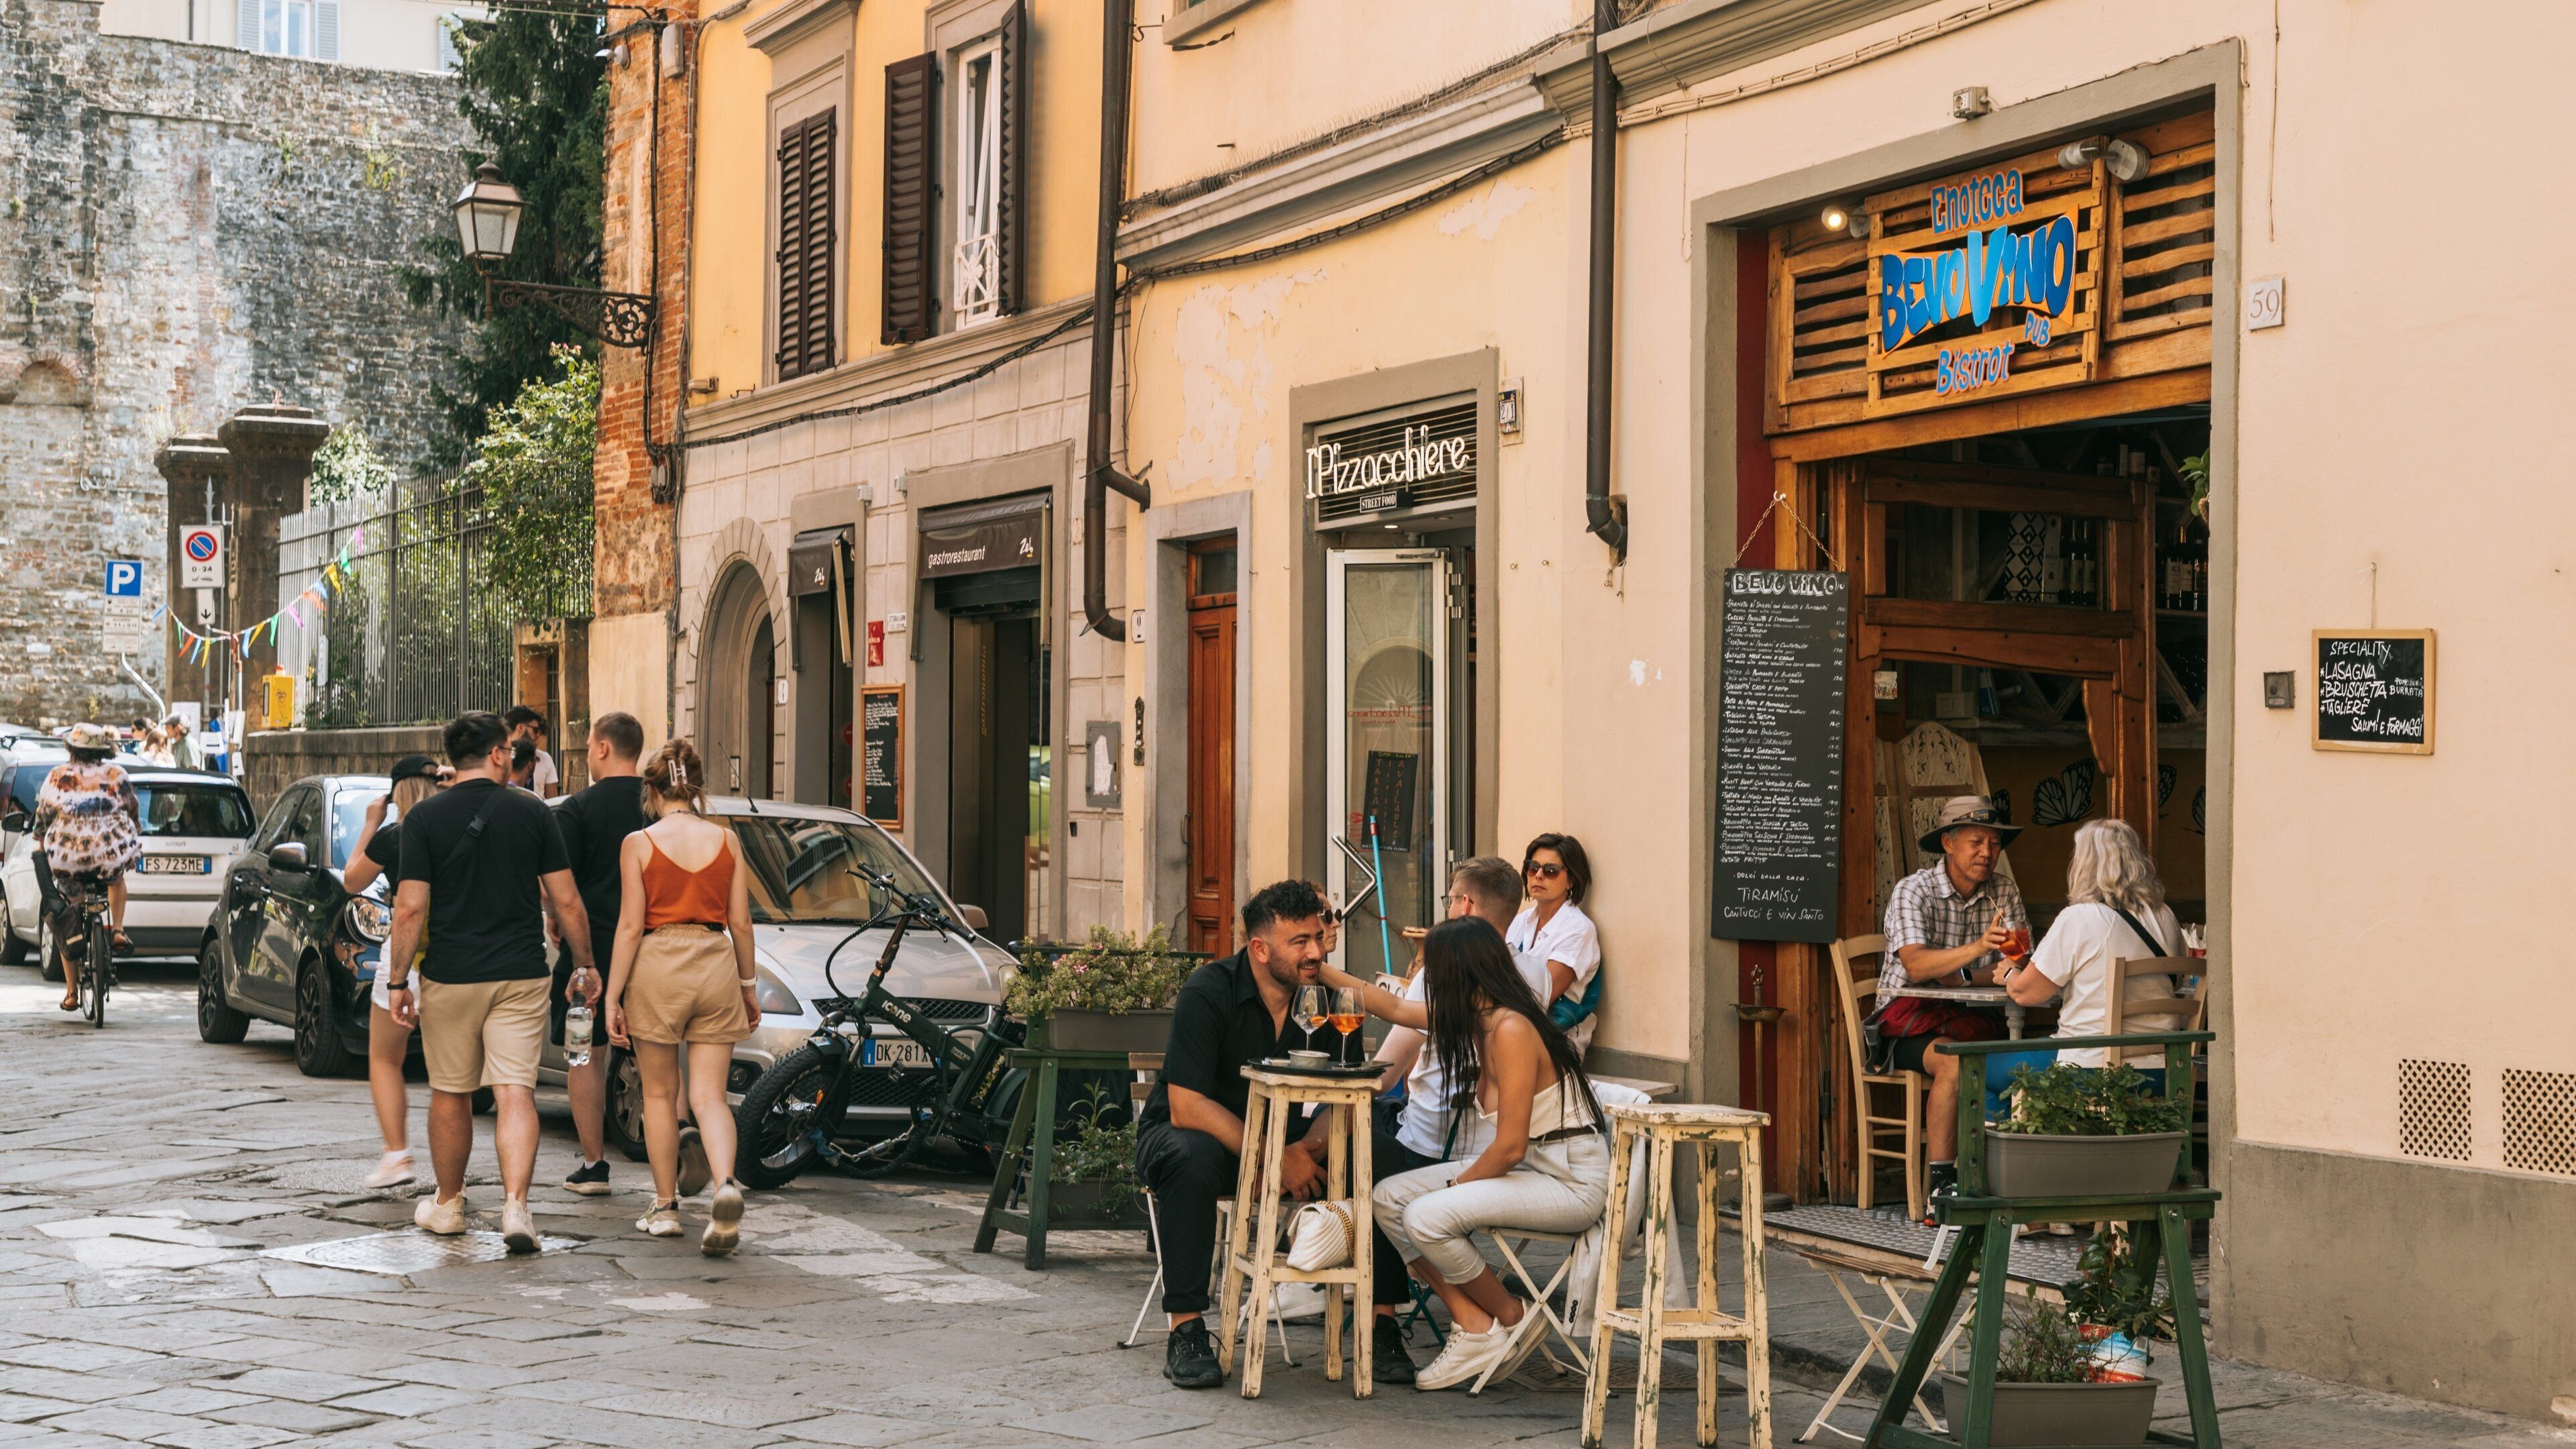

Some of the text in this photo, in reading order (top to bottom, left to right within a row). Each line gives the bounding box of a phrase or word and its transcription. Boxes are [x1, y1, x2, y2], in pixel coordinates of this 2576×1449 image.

[1931, 169, 2024, 234] Enoteca
[2250, 288, 2279, 320] 59
[2024, 311, 2051, 346] PUB
[1937, 341, 2014, 394] Bistrot
[1362, 494, 1395, 509] STREET FOOD
[928, 545, 985, 569] gastrorestaurant
[112, 564, 135, 594] P
[1731, 571, 1838, 596] BEVO VINO
[2330, 640, 2391, 664] SPECIALITY
[2325, 660, 2376, 680] LASAGNA
[2323, 680, 2387, 699] BRUSCHETTA
[2351, 709, 2424, 737] SALUMI E FORMAGGI
[165, 858, 204, 871] 723ME
[1737, 871, 1756, 879] DOLCI
[1724, 906, 1824, 921] CANTUCCI E VIN SANTO
